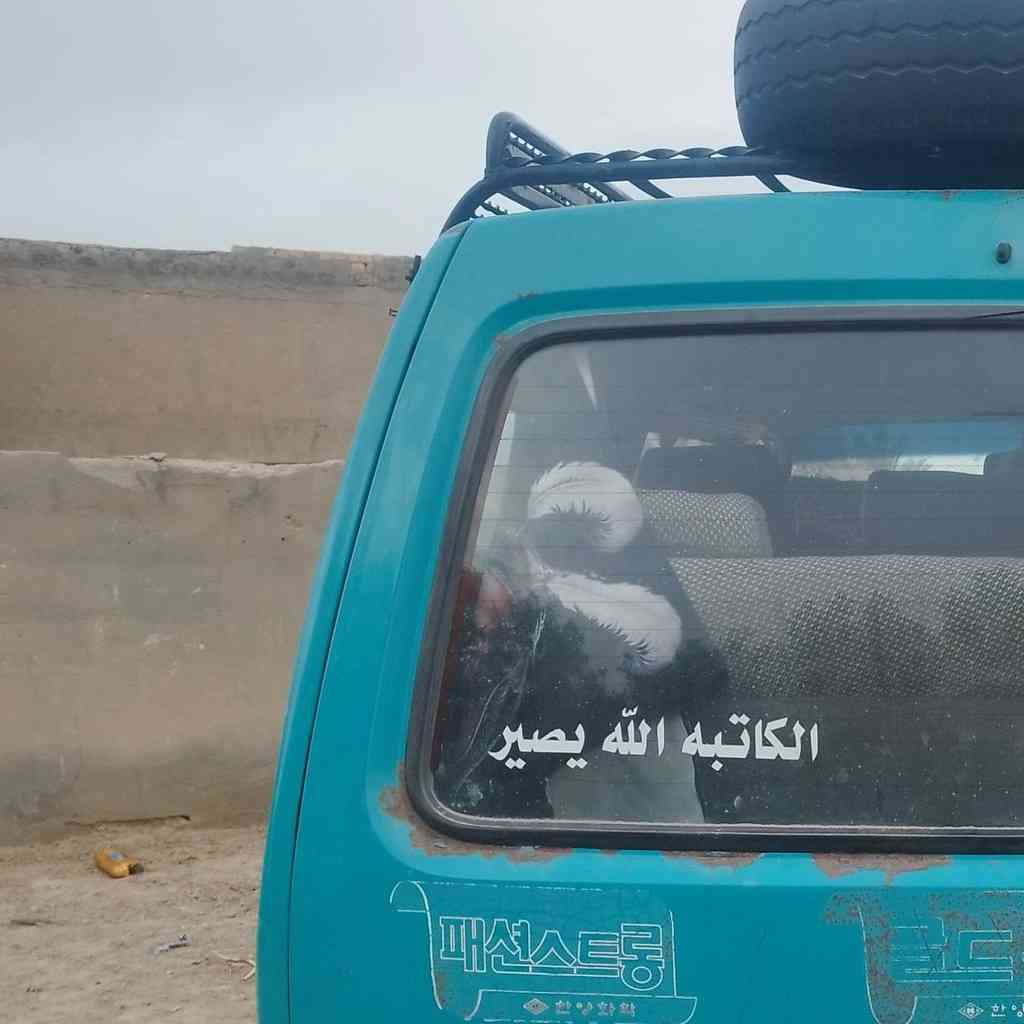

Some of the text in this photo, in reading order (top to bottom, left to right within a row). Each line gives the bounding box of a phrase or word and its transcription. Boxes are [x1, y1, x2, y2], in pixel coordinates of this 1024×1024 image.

[487, 704, 820, 772] الكاتبه الله يصير
[439, 915, 665, 992] 패션스트롱
